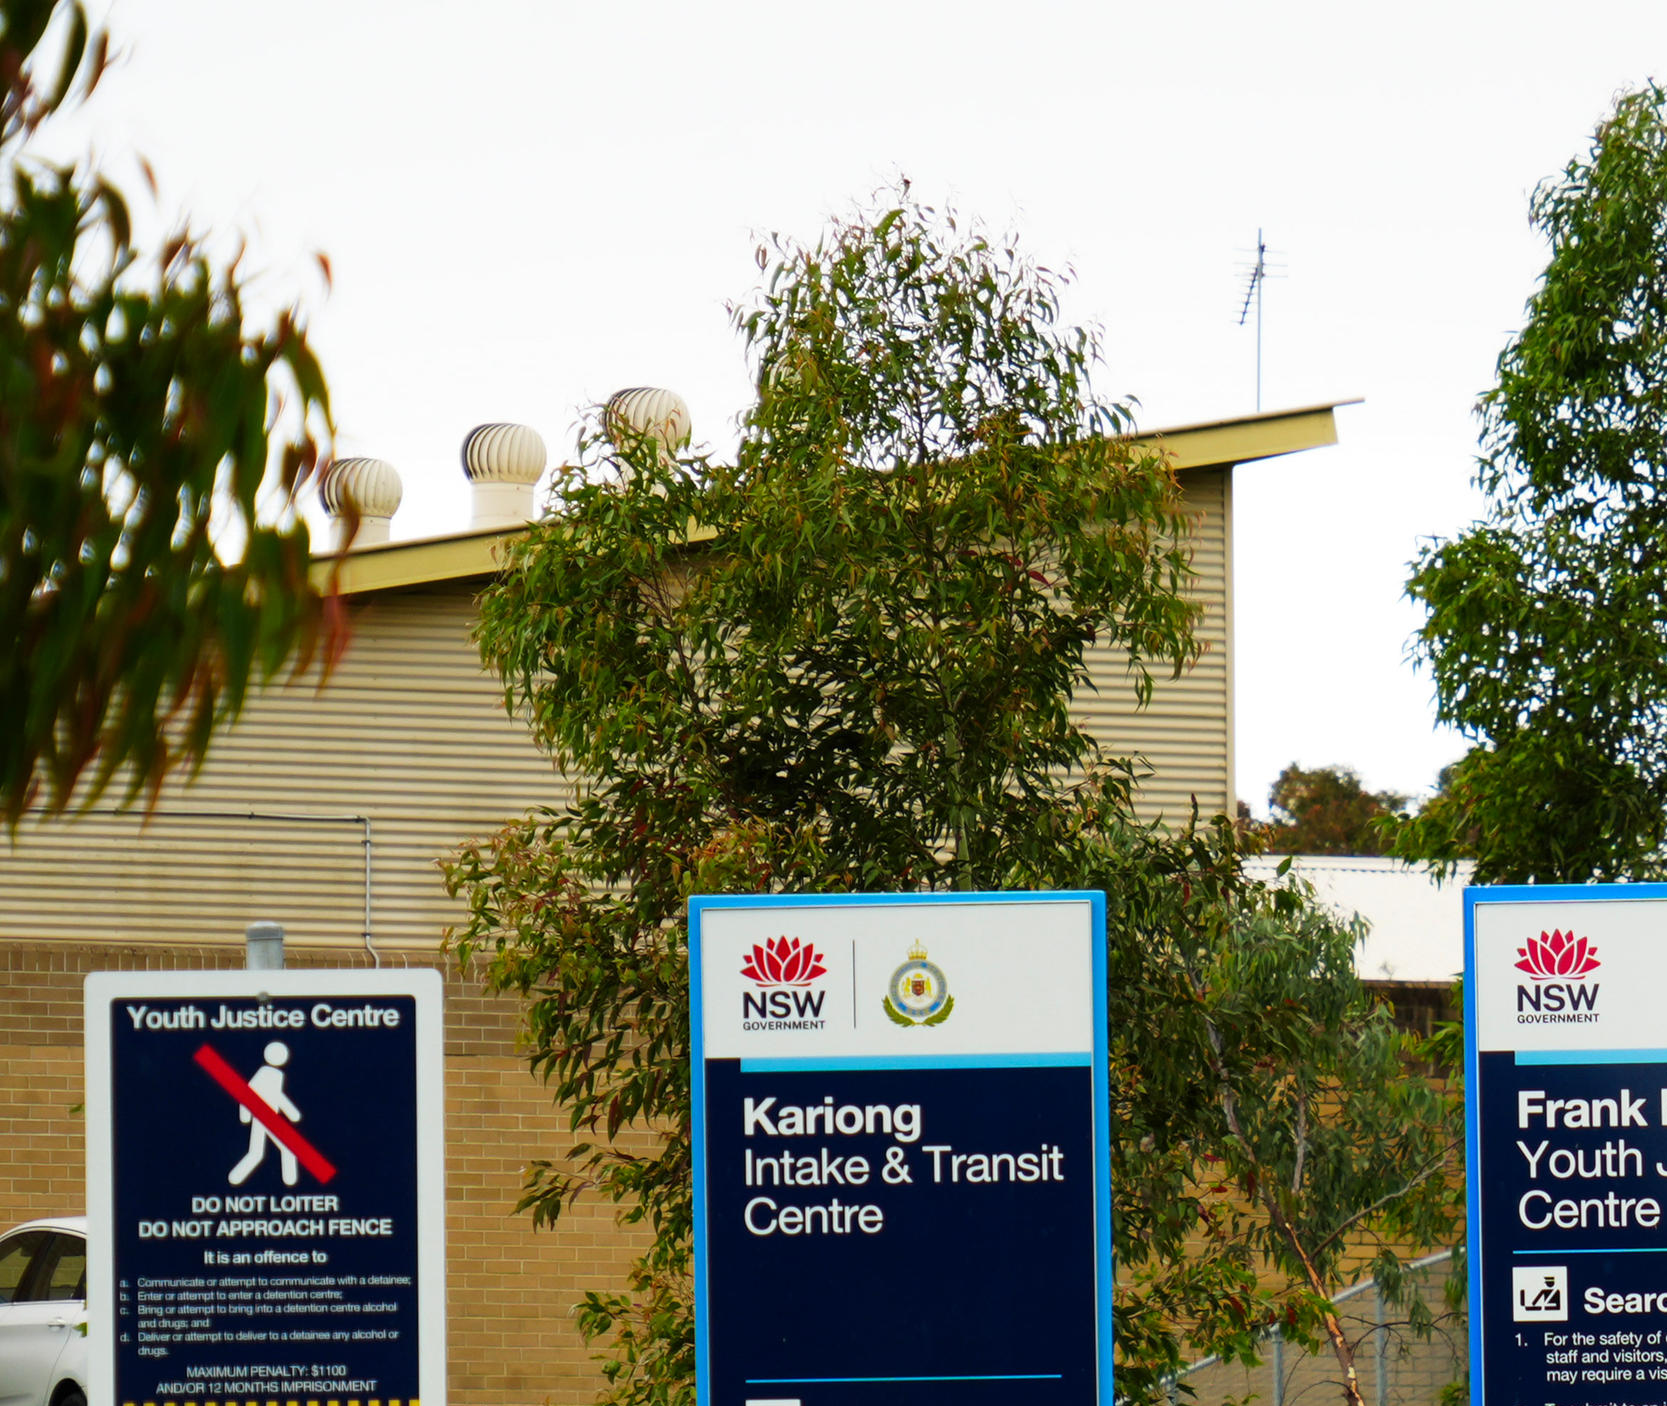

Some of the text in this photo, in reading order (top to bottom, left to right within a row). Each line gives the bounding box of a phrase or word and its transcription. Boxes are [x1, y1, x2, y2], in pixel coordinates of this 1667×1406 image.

[743, 991, 826, 1019] NSW
[1517, 984, 1599, 1012] NSW
[126, 1003, 400, 1029] Youth Justice Centre
[742, 1020, 826, 1031] GOVERNMENT
[1517, 1013, 1599, 1024] GOVERNMENT
[743, 1096, 921, 1142] Kariong
[1518, 1088, 1648, 1128] Frank
[745, 1143, 1064, 1185] Intake & Transit
[1516, 1138, 1642, 1178] Youth
[191, 1195, 339, 1213] DO NOT LOITER
[744, 1196, 883, 1235] Centre
[1518, 1189, 1660, 1229] Centre
[138, 1218, 392, 1237] DO NOT APPROACH FENCE
[204, 1249, 328, 1264] It is an offence to
[1515, 1333, 1527, 1346] 1.
[1544, 1332, 1568, 1346] For
[1571, 1331, 1595, 1345] the
[1599, 1330, 1643, 1348] safety
[1646, 1330, 1661, 1344] of
[186, 1364, 346, 1378] MAXIMUM PENALTY: $1100
[155, 1380, 377, 1394] AND/OR 12 MONTHS IMPRISONMENT
